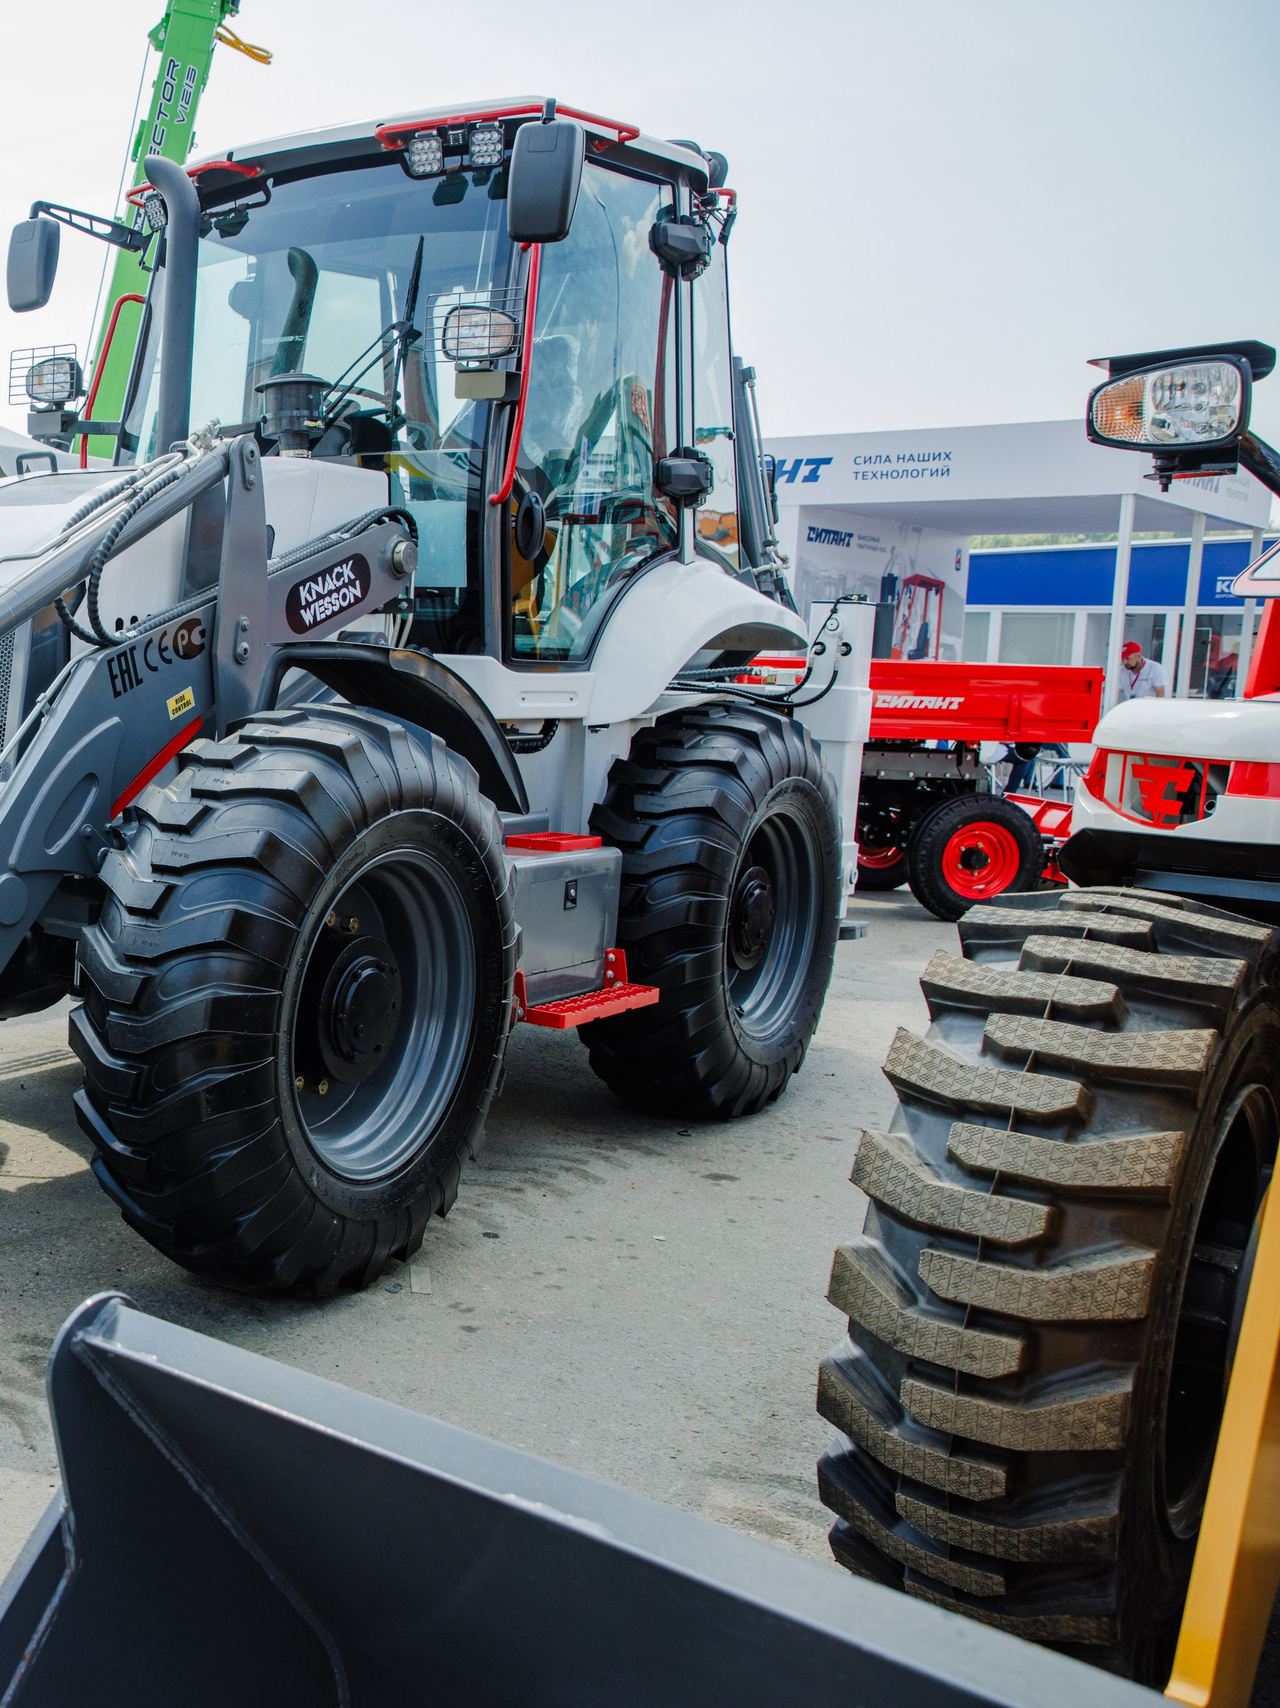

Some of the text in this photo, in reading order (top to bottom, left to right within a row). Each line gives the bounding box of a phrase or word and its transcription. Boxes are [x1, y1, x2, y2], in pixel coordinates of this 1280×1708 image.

[853, 451, 952, 465] СИЛА НАШИХ
[852, 465, 951, 481] ТЕХНОЛОГИЙ
[806, 525, 854, 549] СИЛАНТ
[299, 559, 356, 606] KNACK
[299, 580, 362, 627] WESSON
[171, 699, 192, 716] CONTROL
[174, 694, 186, 706] RIDE
[874, 694, 965, 710] СИЛАНТ
